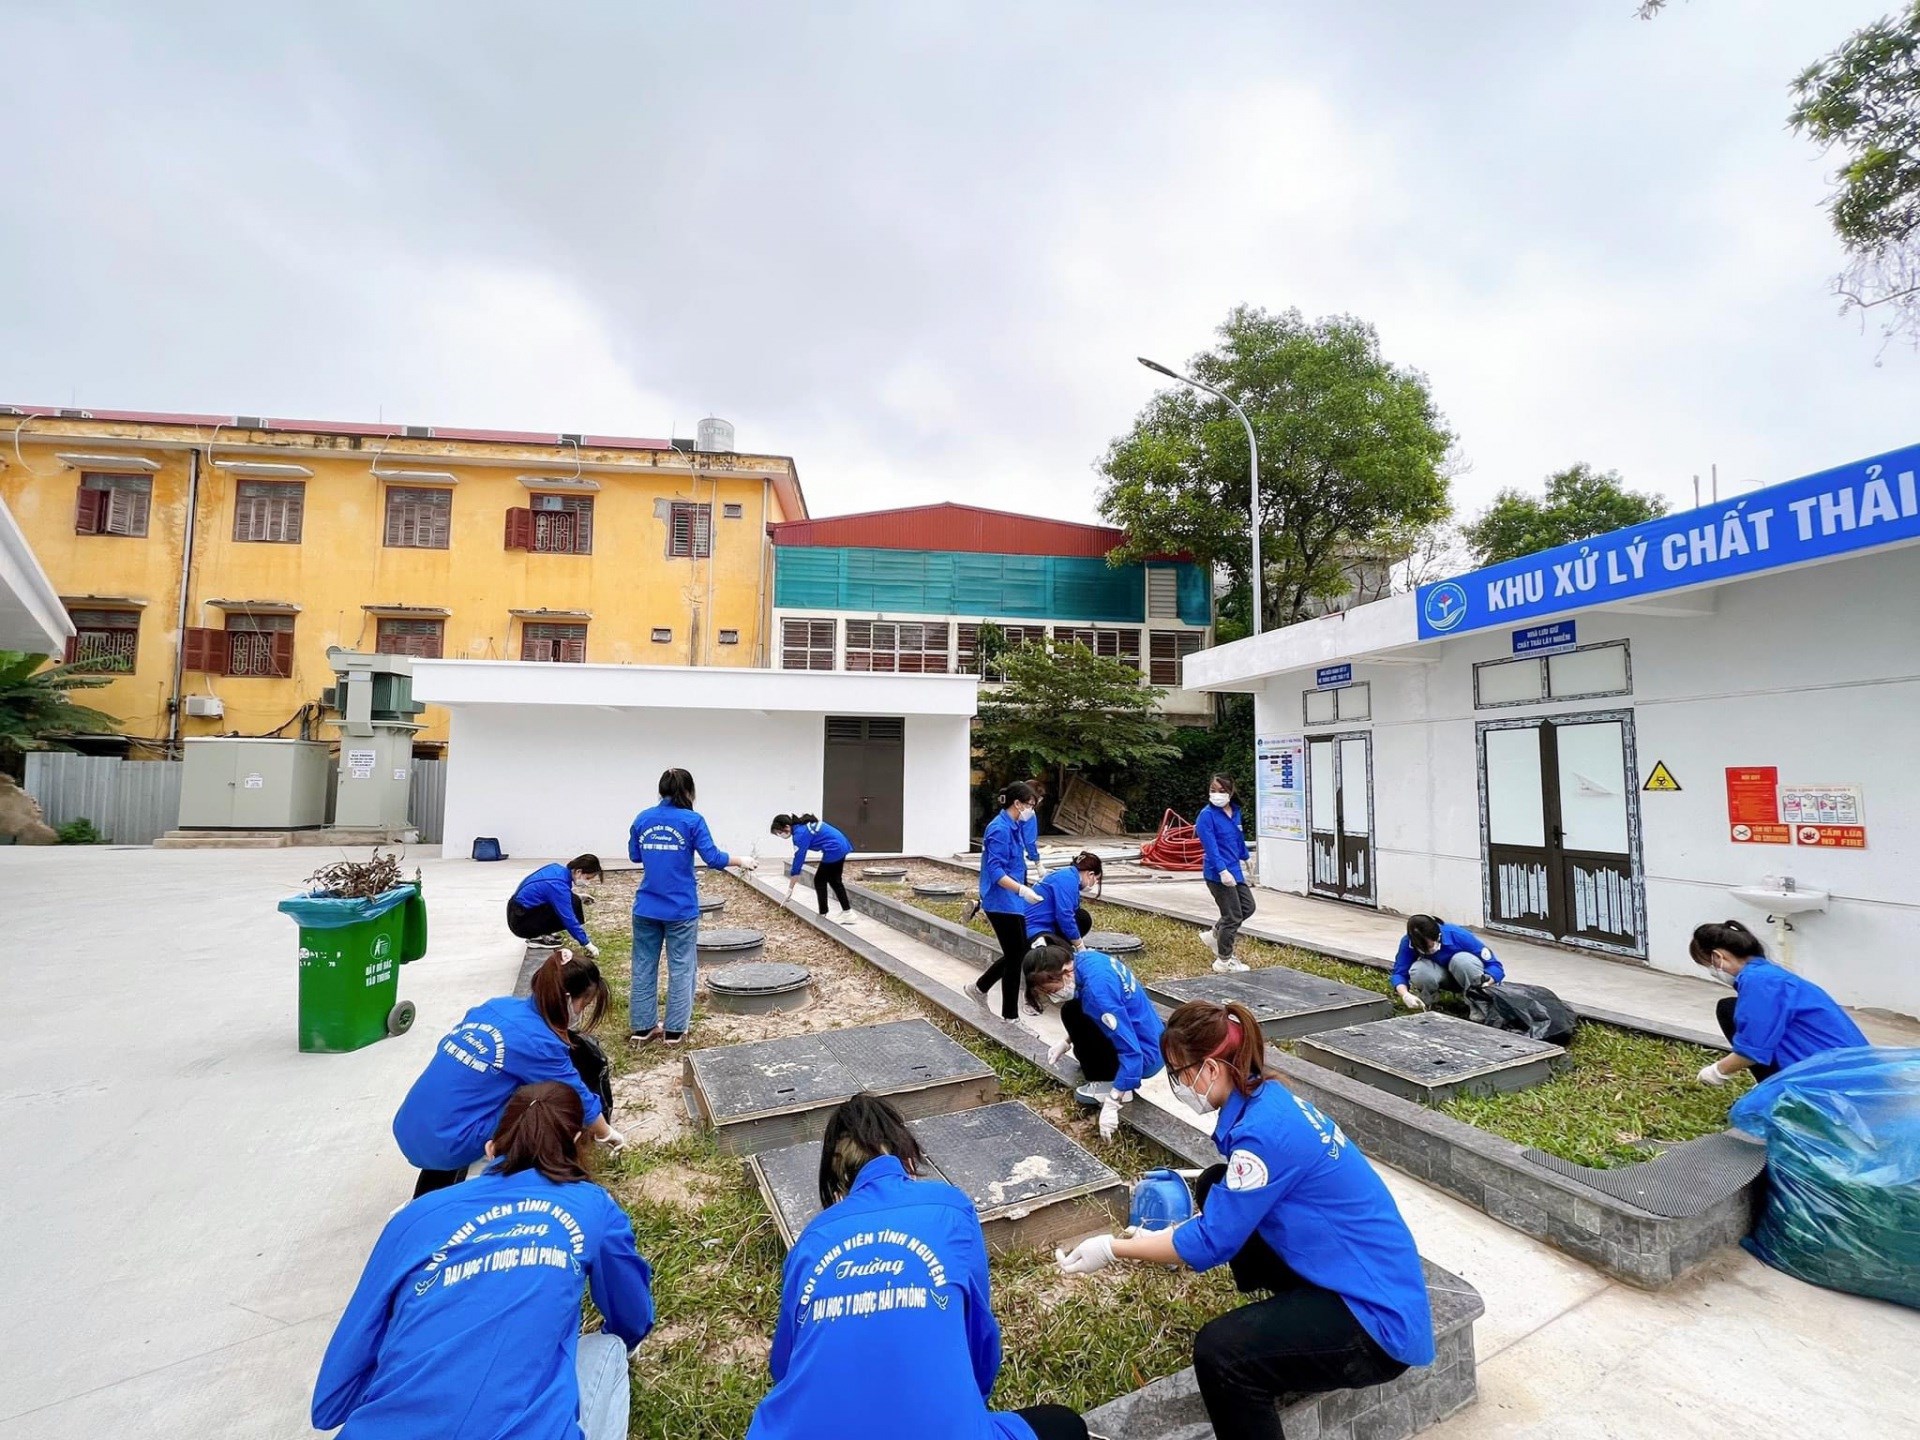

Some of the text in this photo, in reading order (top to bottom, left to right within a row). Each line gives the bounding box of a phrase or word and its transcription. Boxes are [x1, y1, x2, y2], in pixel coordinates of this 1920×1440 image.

[1487, 569, 1544, 612] KHU
[1553, 546, 1600, 596] XỬ
[1608, 536, 1648, 586] LÝ
[1661, 501, 1774, 571] CHẤT
[1789, 464, 1918, 542] THẢI
[1820, 827, 1840, 836] CẤM
[1841, 838, 1864, 846] FIRE
[476, 1203, 513, 1225] VIÊN
[517, 1198, 551, 1213] TÌNH
[551, 1206, 585, 1254] NGUYỆN
[443, 1240, 568, 1286] ĐẠI HỌC Y DƯỢC HẢI PHÒNG
[800, 1229, 948, 1306] ĐỘI SINH VIÊN TÌNH NGUYỆN
[836, 1256, 904, 1280] Trường
[813, 1281, 928, 1324] ĐẠI HỌC Y DƯỢC HẢI PHÒNG
